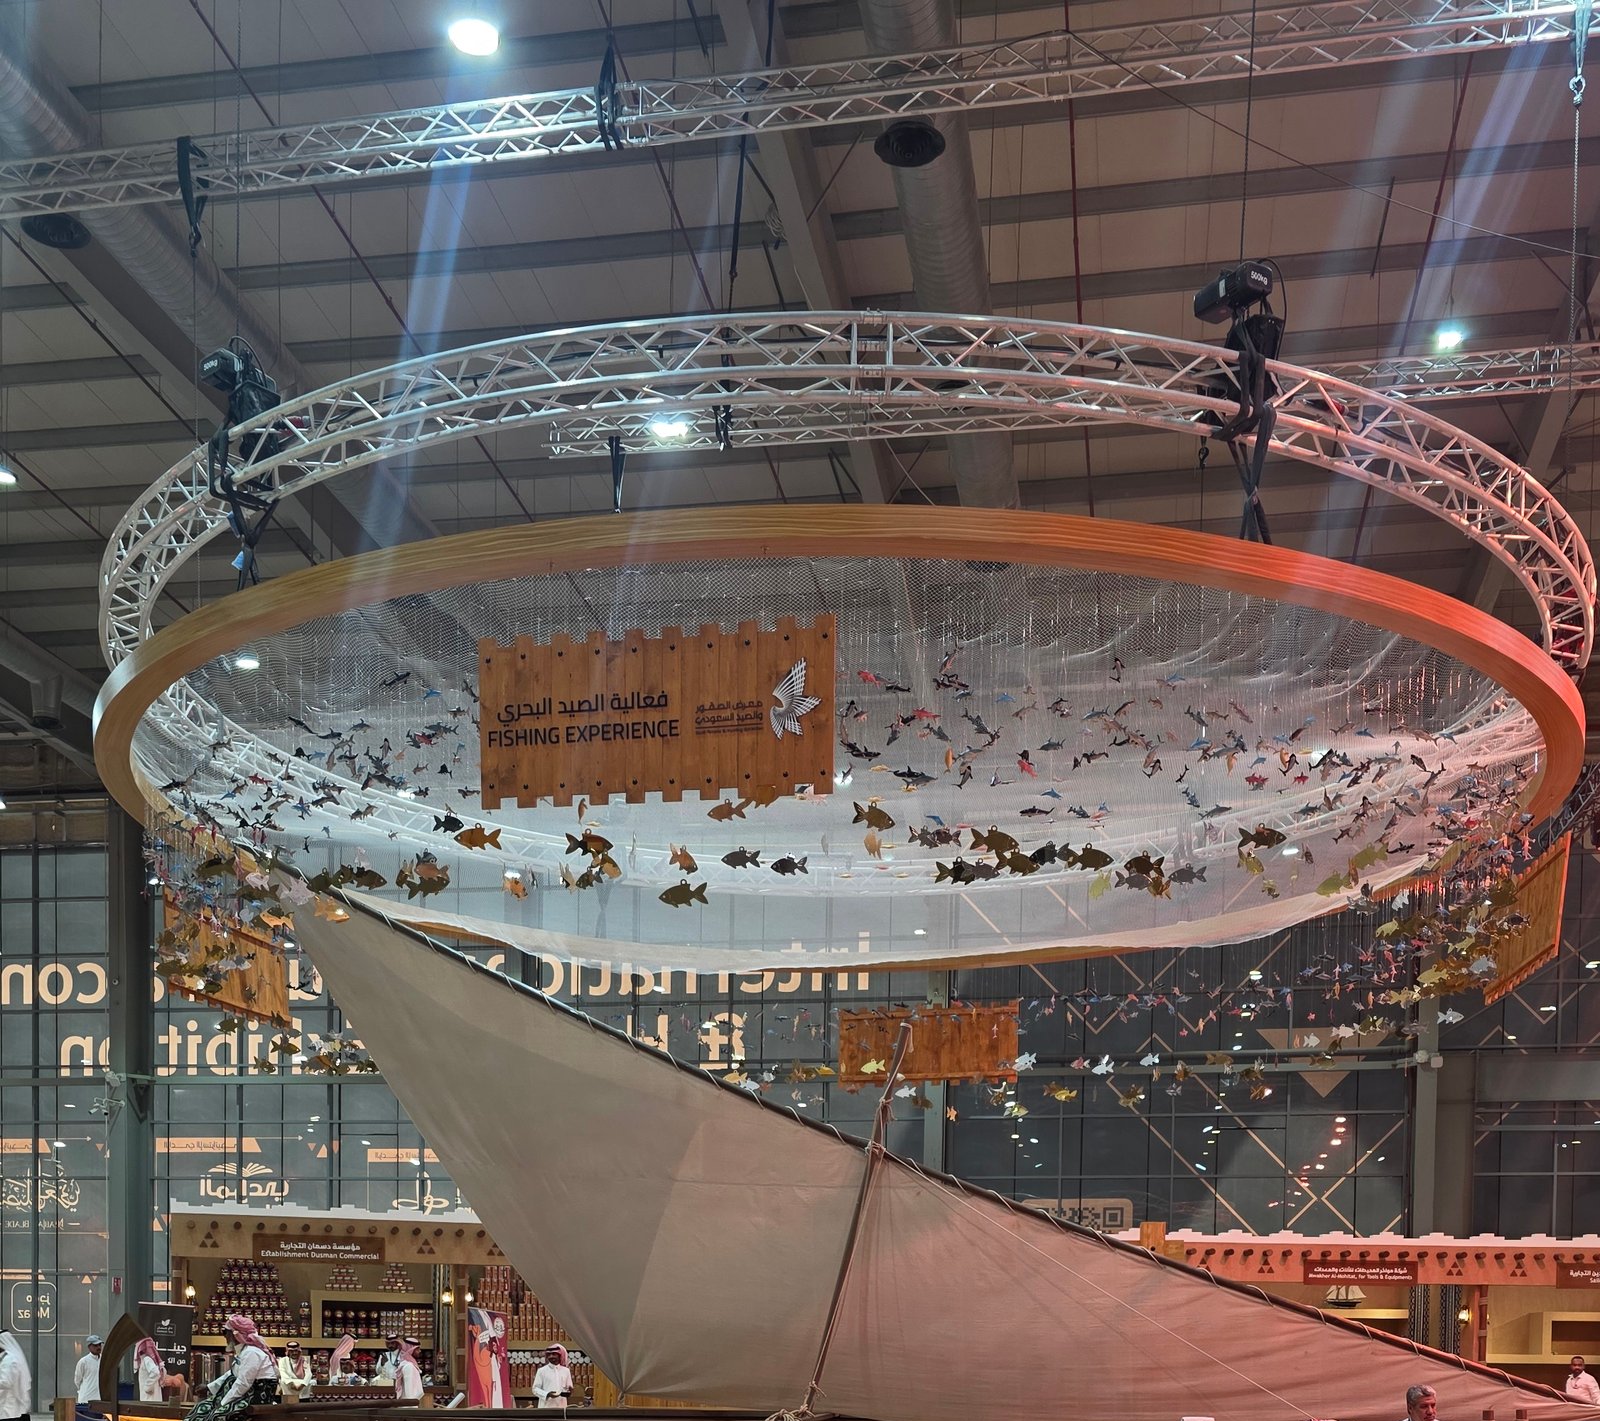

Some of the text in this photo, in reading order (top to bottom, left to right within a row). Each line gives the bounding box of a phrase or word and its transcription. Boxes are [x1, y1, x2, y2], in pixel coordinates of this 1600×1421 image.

[1250, 270, 1268, 285] 500kg
[497, 690, 668, 727] فعالية الصيد البحري
[488, 719, 680, 748] FISHING EXPERIENCE
[280, 1241, 307, 1251] التجارية
[332, 1243, 361, 1252] مؤسسة
[261, 1250, 379, 1260] Establishment Dusman Commercial
[1570, 1269, 1591, 1277] التجارية
